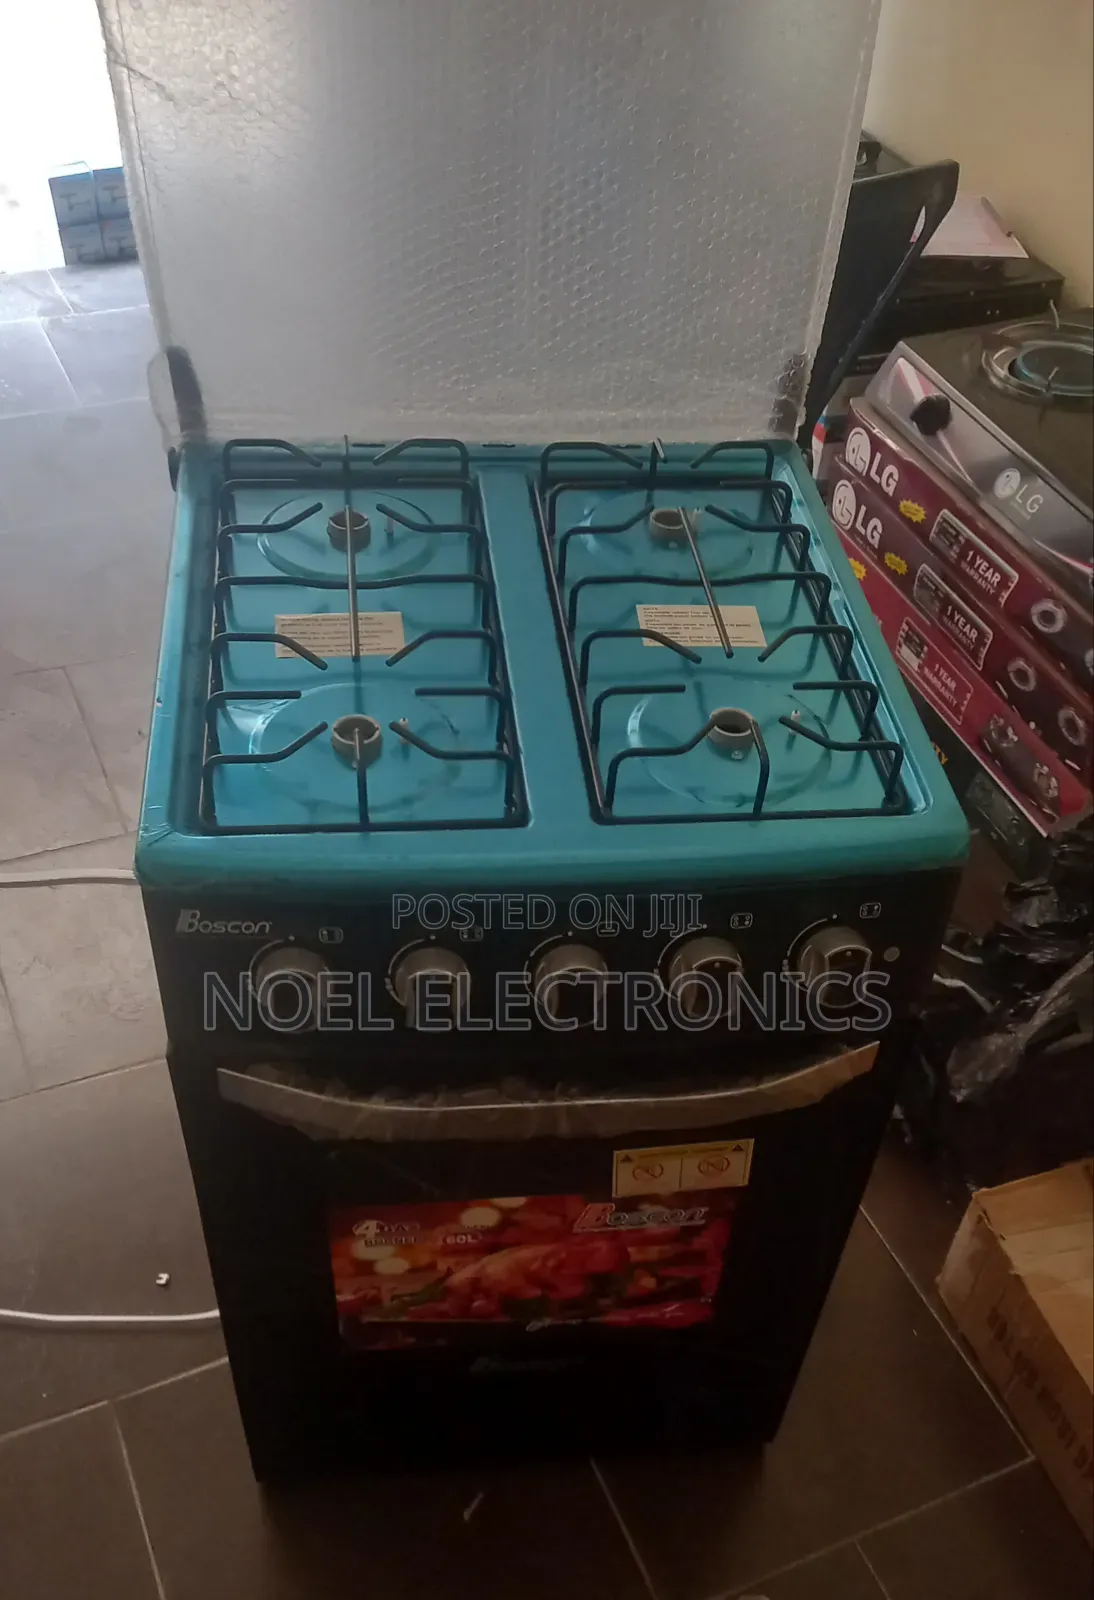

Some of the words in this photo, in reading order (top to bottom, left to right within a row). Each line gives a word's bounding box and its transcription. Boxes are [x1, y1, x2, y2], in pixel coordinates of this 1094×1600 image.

[870, 452, 899, 497] LG
[855, 504, 883, 549] LG
[960, 560, 996, 596] WARRANTY
[966, 550, 973, 561] 1
[974, 555, 1002, 588] YEAR
[946, 605, 953, 616] 1
[952, 609, 979, 643] YEAR
[923, 666, 958, 707] WARRANTY
[939, 666, 957, 691] YEAR
[175, 908, 272, 935] Boscon
